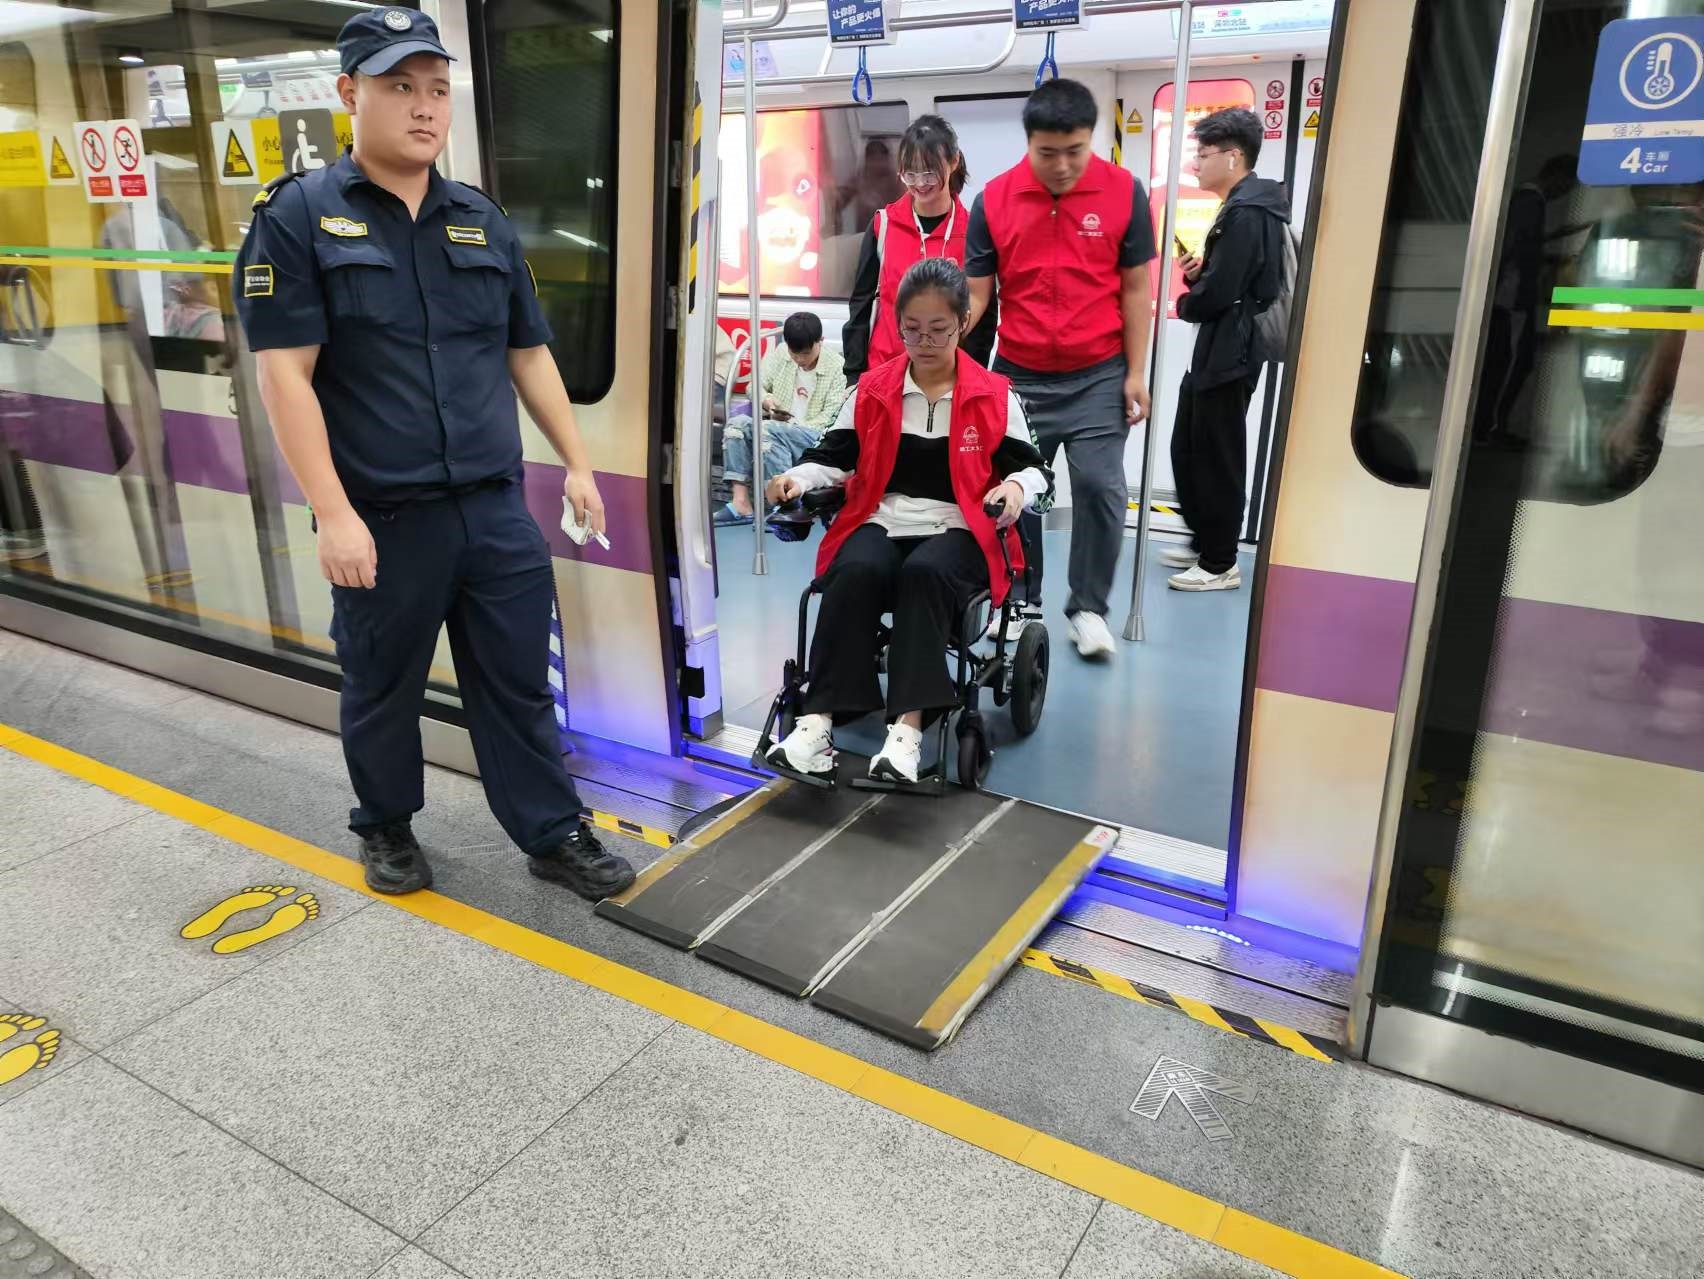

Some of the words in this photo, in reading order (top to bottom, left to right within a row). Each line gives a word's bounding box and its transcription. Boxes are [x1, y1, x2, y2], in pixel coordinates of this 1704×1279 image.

[832, 5, 857, 20] 让你的
[1612, 124, 1644, 137] 强冷
[1619, 146, 1642, 174] 4
[1642, 162, 1669, 173] Car
